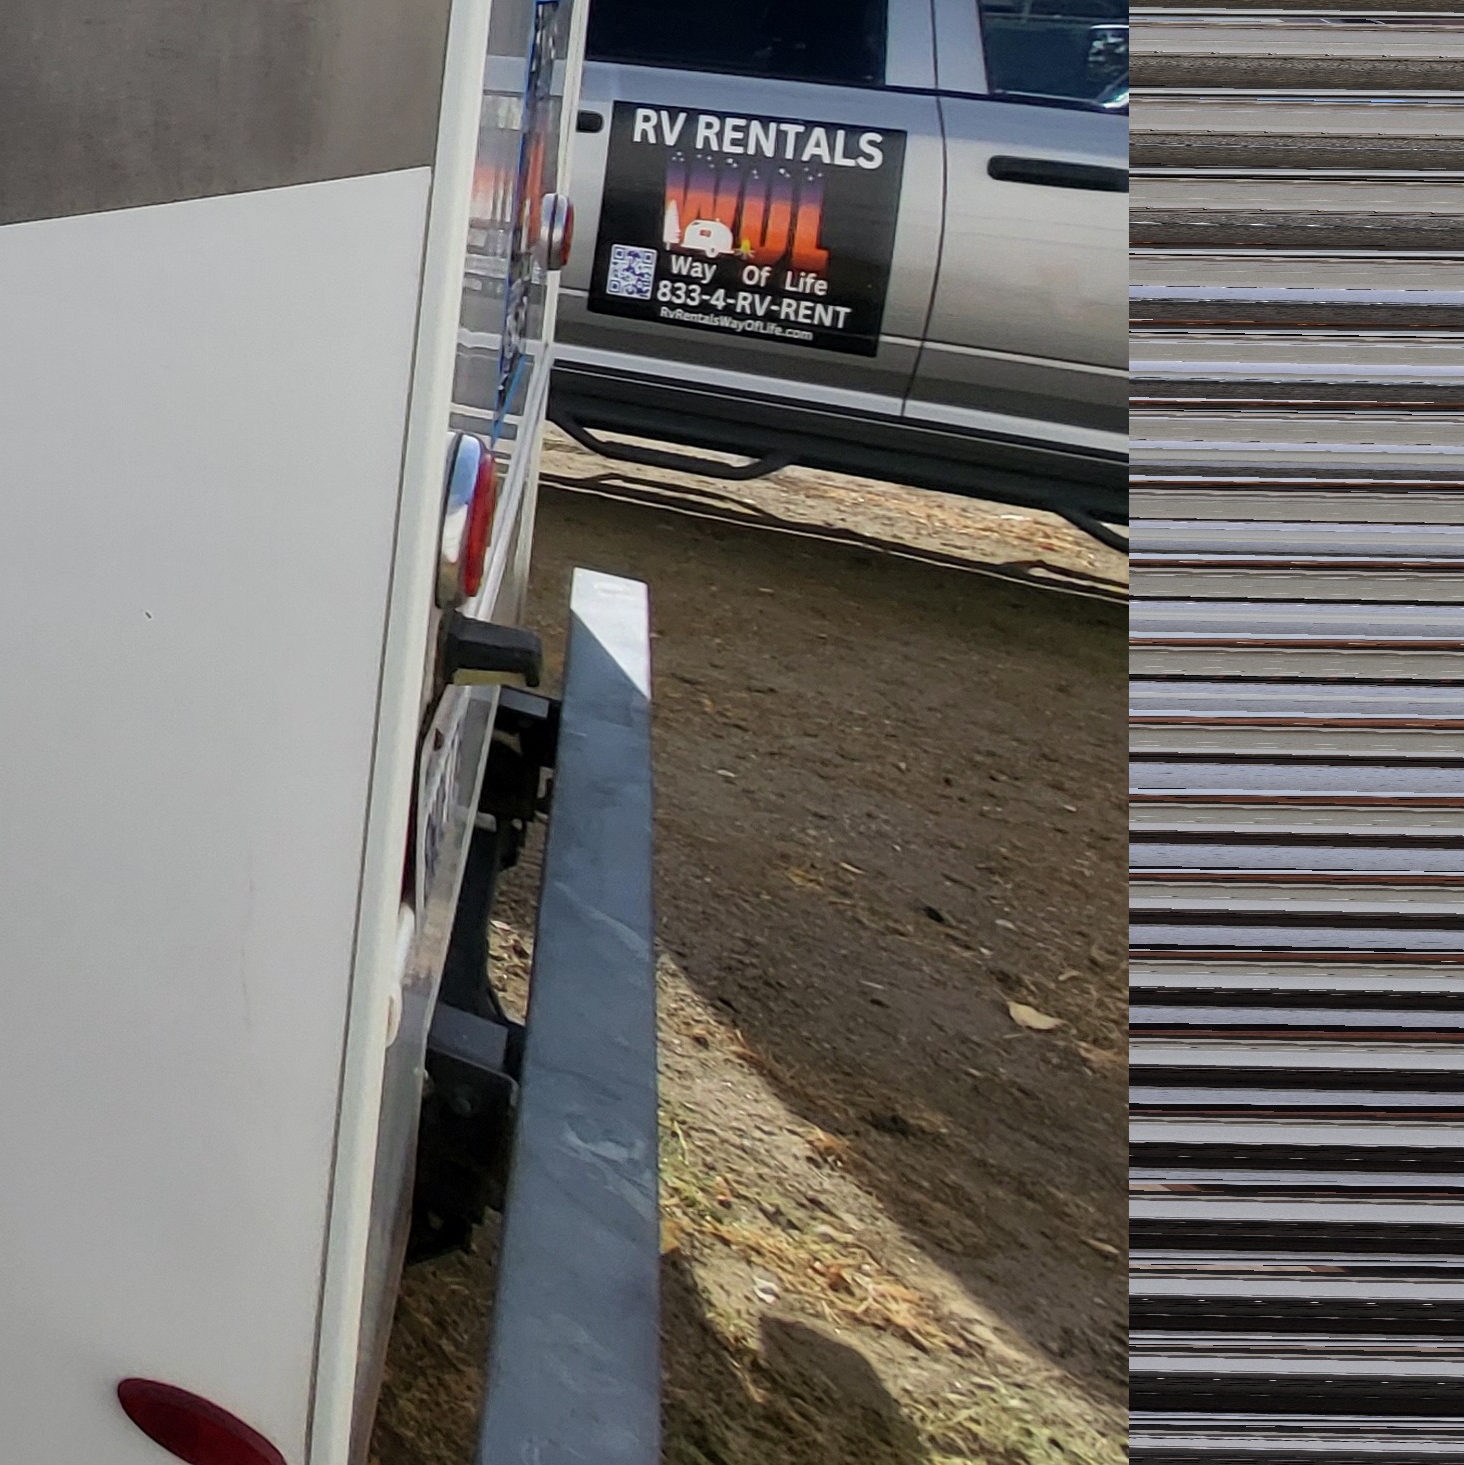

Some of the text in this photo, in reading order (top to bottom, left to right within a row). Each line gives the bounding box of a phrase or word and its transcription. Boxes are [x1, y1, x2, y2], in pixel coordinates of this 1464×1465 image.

[633, 108, 884, 170] RV RENTALS
[671, 255, 829, 296] Way Of Life
[657, 280, 852, 329] 833-4-RV-RENT
[660, 307, 814, 341] RvRentalsWayOfLife.com
